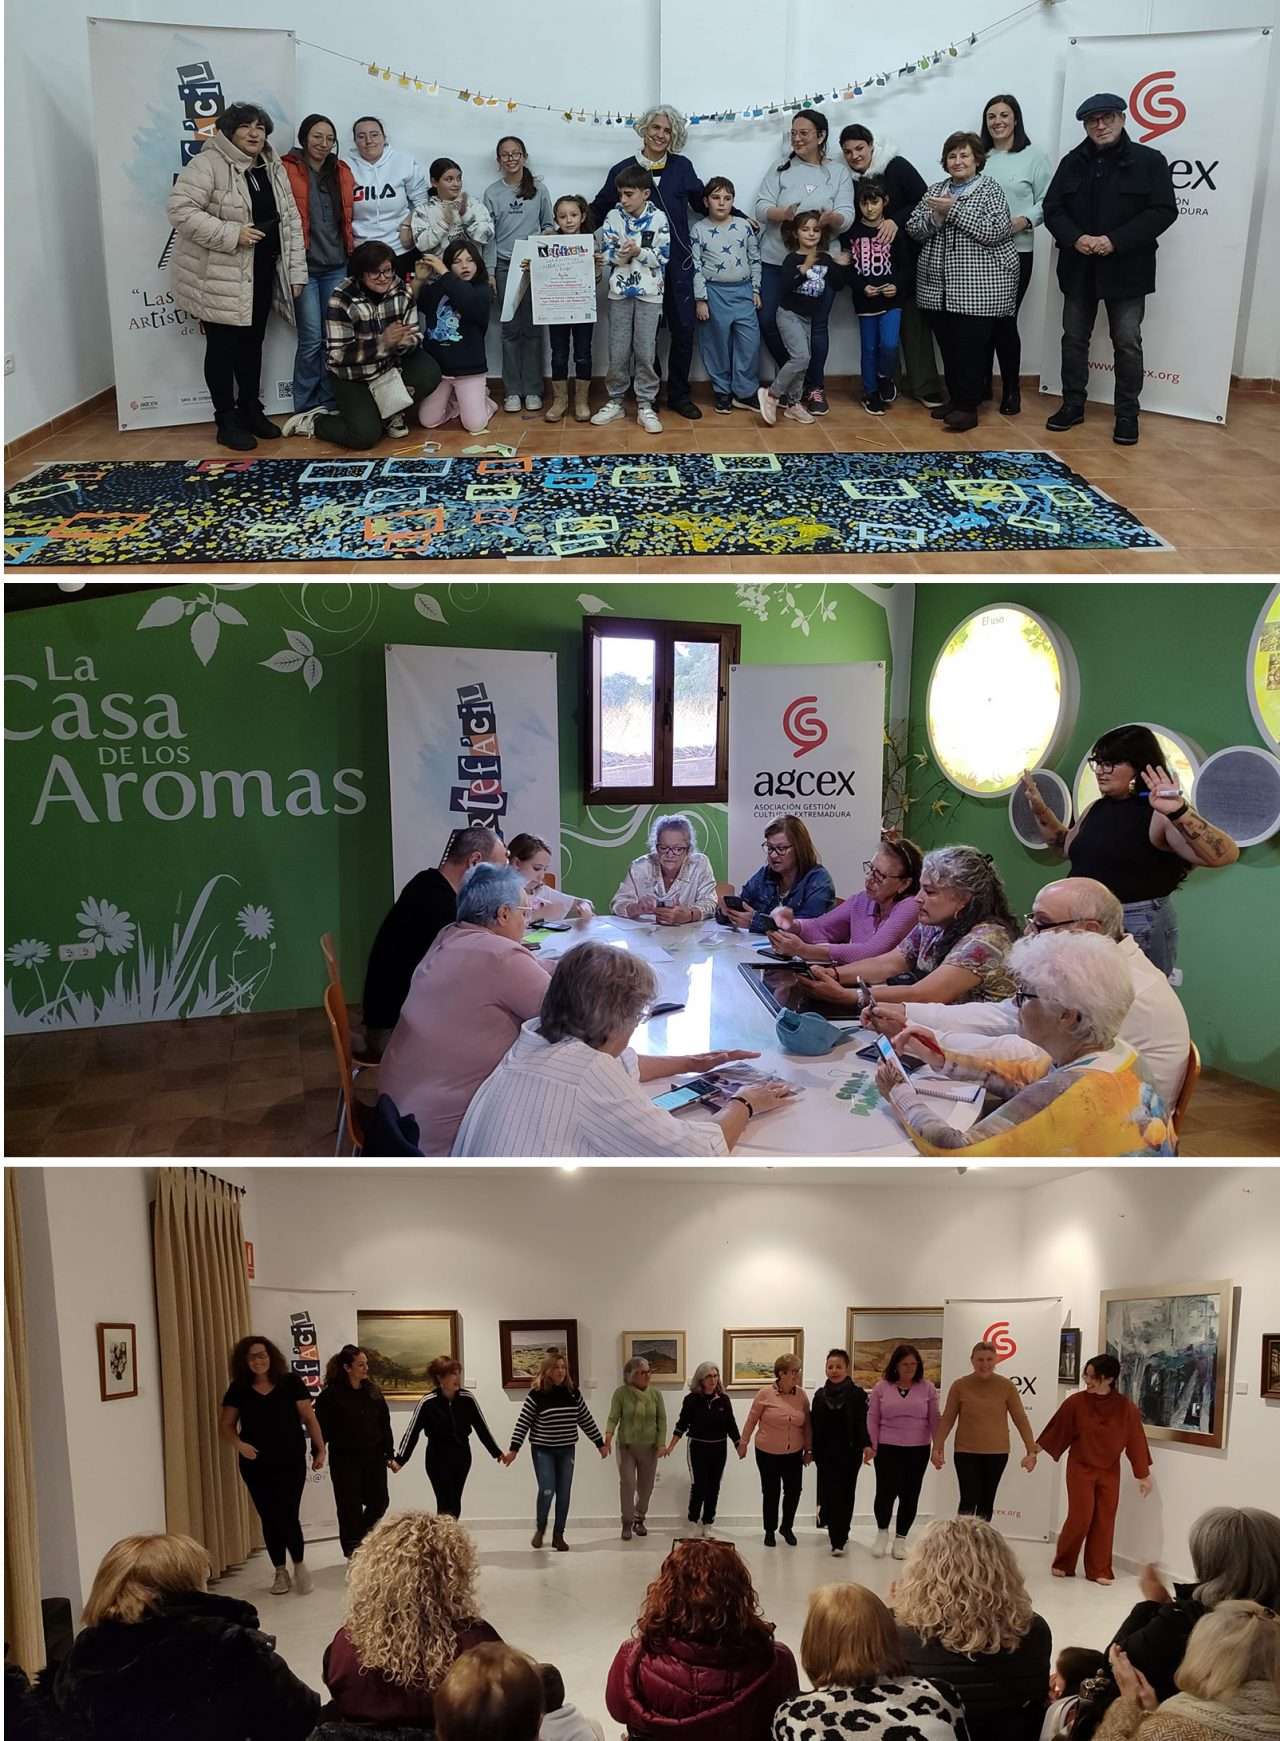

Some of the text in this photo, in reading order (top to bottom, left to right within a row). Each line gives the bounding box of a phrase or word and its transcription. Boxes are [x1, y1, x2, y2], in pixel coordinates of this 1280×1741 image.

[45, 646, 99, 682] La
[5, 674, 188, 741] Casa
[98, 746, 191, 765] DE LOS
[30, 754, 367, 825] Aromas
[753, 769, 856, 799] agcex
